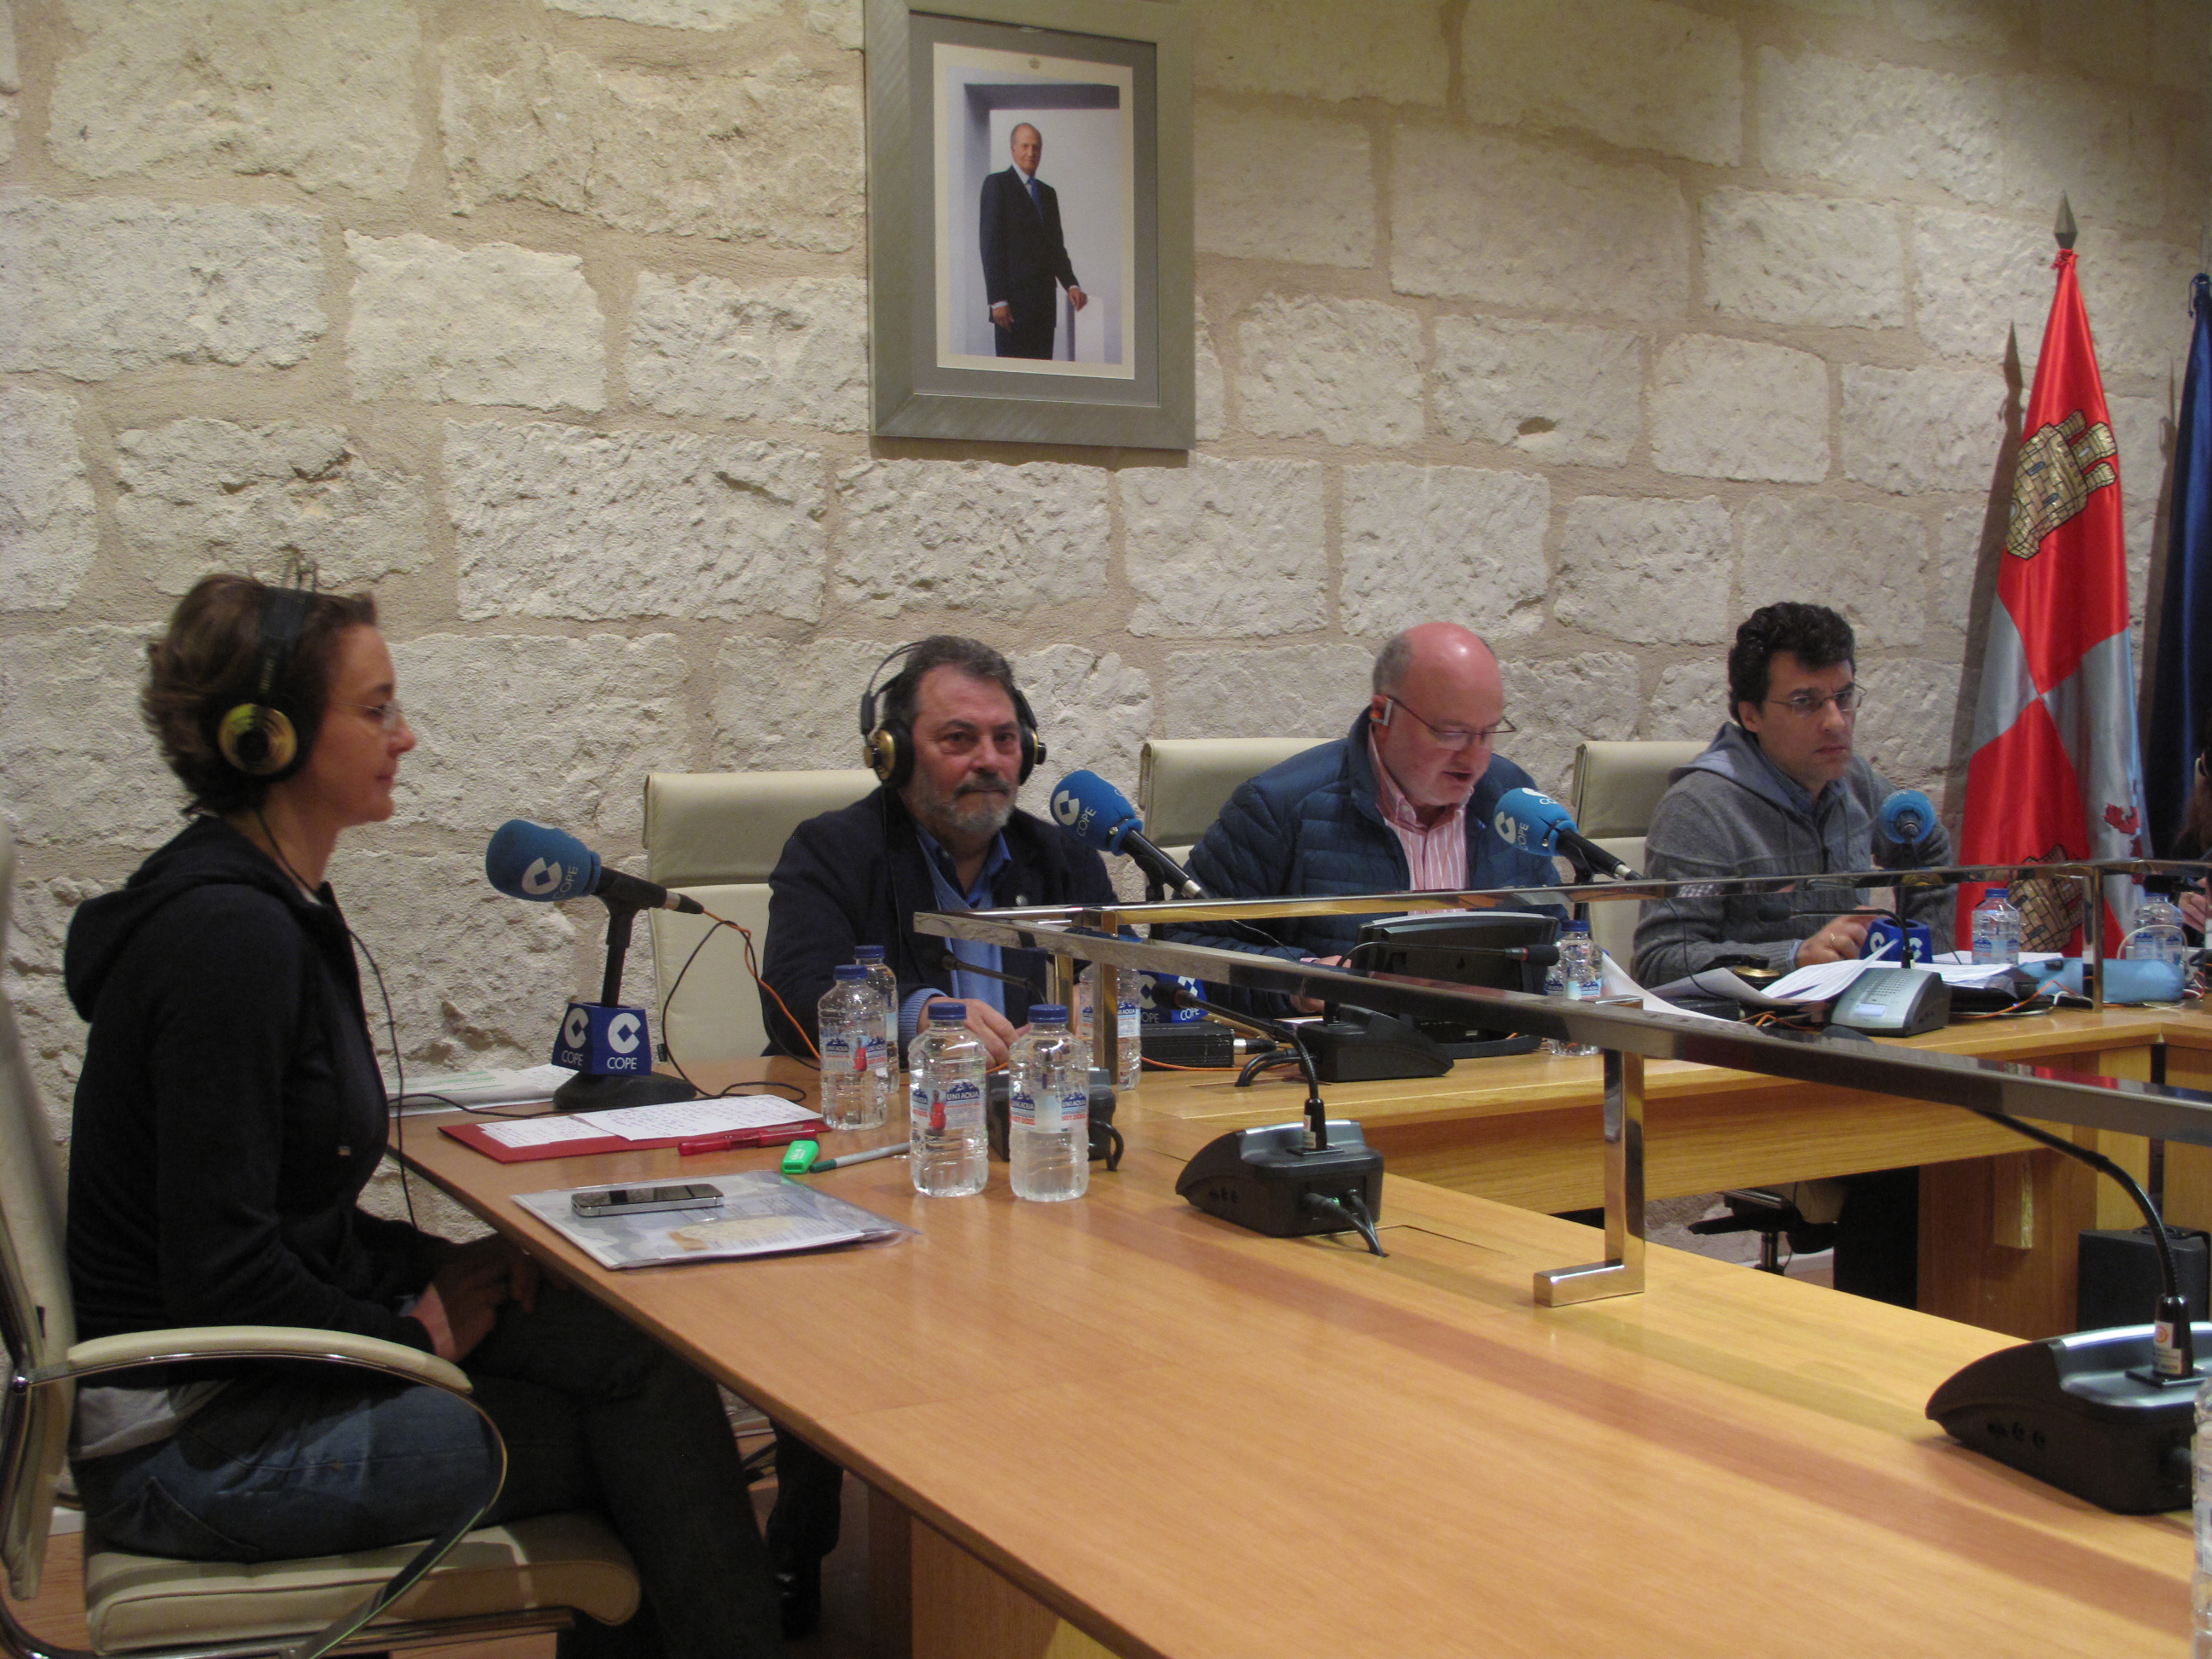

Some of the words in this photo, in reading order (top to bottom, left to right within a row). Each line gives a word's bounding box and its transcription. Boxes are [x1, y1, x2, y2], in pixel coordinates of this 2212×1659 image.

[1076, 806, 1097, 836] COPE
[1517, 822, 1529, 851] COPE
[552, 865, 578, 899] COPE
[1141, 1011, 1160, 1023] OPE
[1180, 1008, 1200, 1021] COPE
[562, 1050, 584, 1066] COPE
[607, 1057, 637, 1069] COPE
